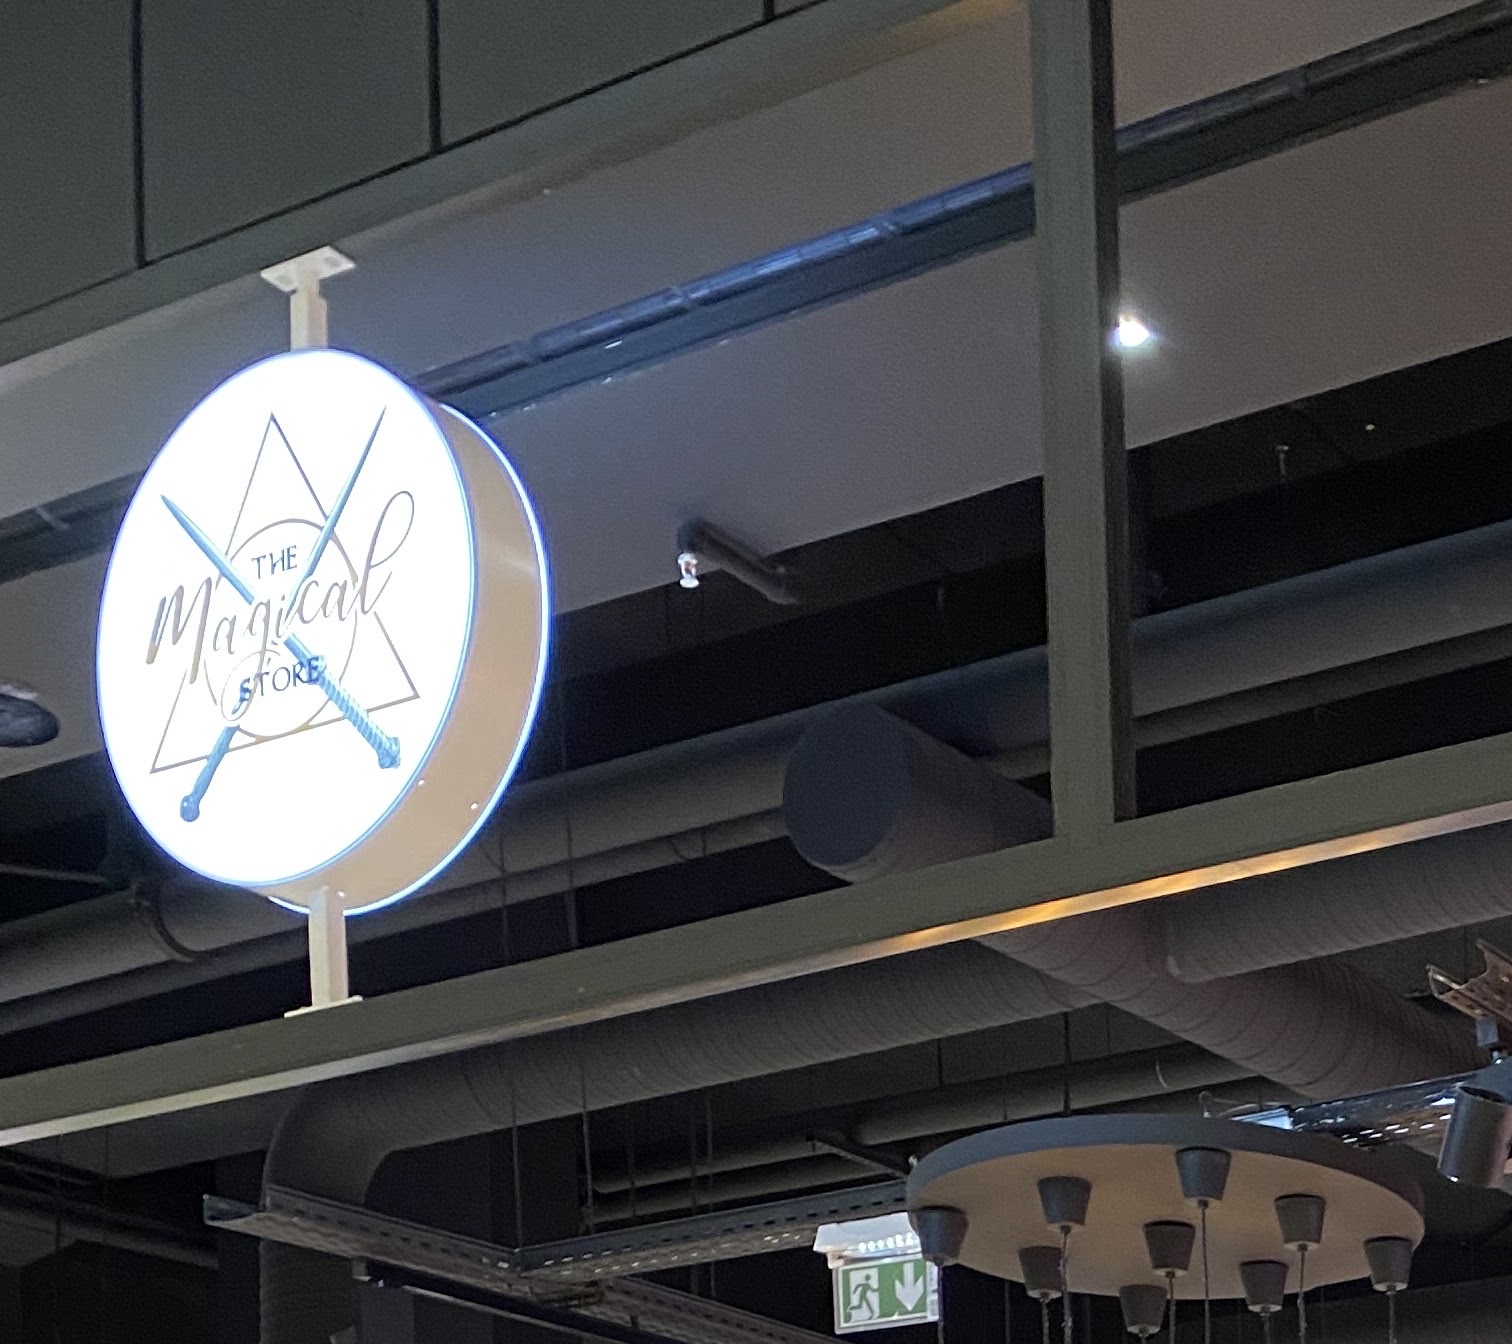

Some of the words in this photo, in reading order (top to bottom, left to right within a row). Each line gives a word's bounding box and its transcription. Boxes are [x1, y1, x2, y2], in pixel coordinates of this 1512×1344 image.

[251, 546, 297, 579] THE
[145, 490, 415, 716] Magical
[239, 656, 321, 702] STORE
